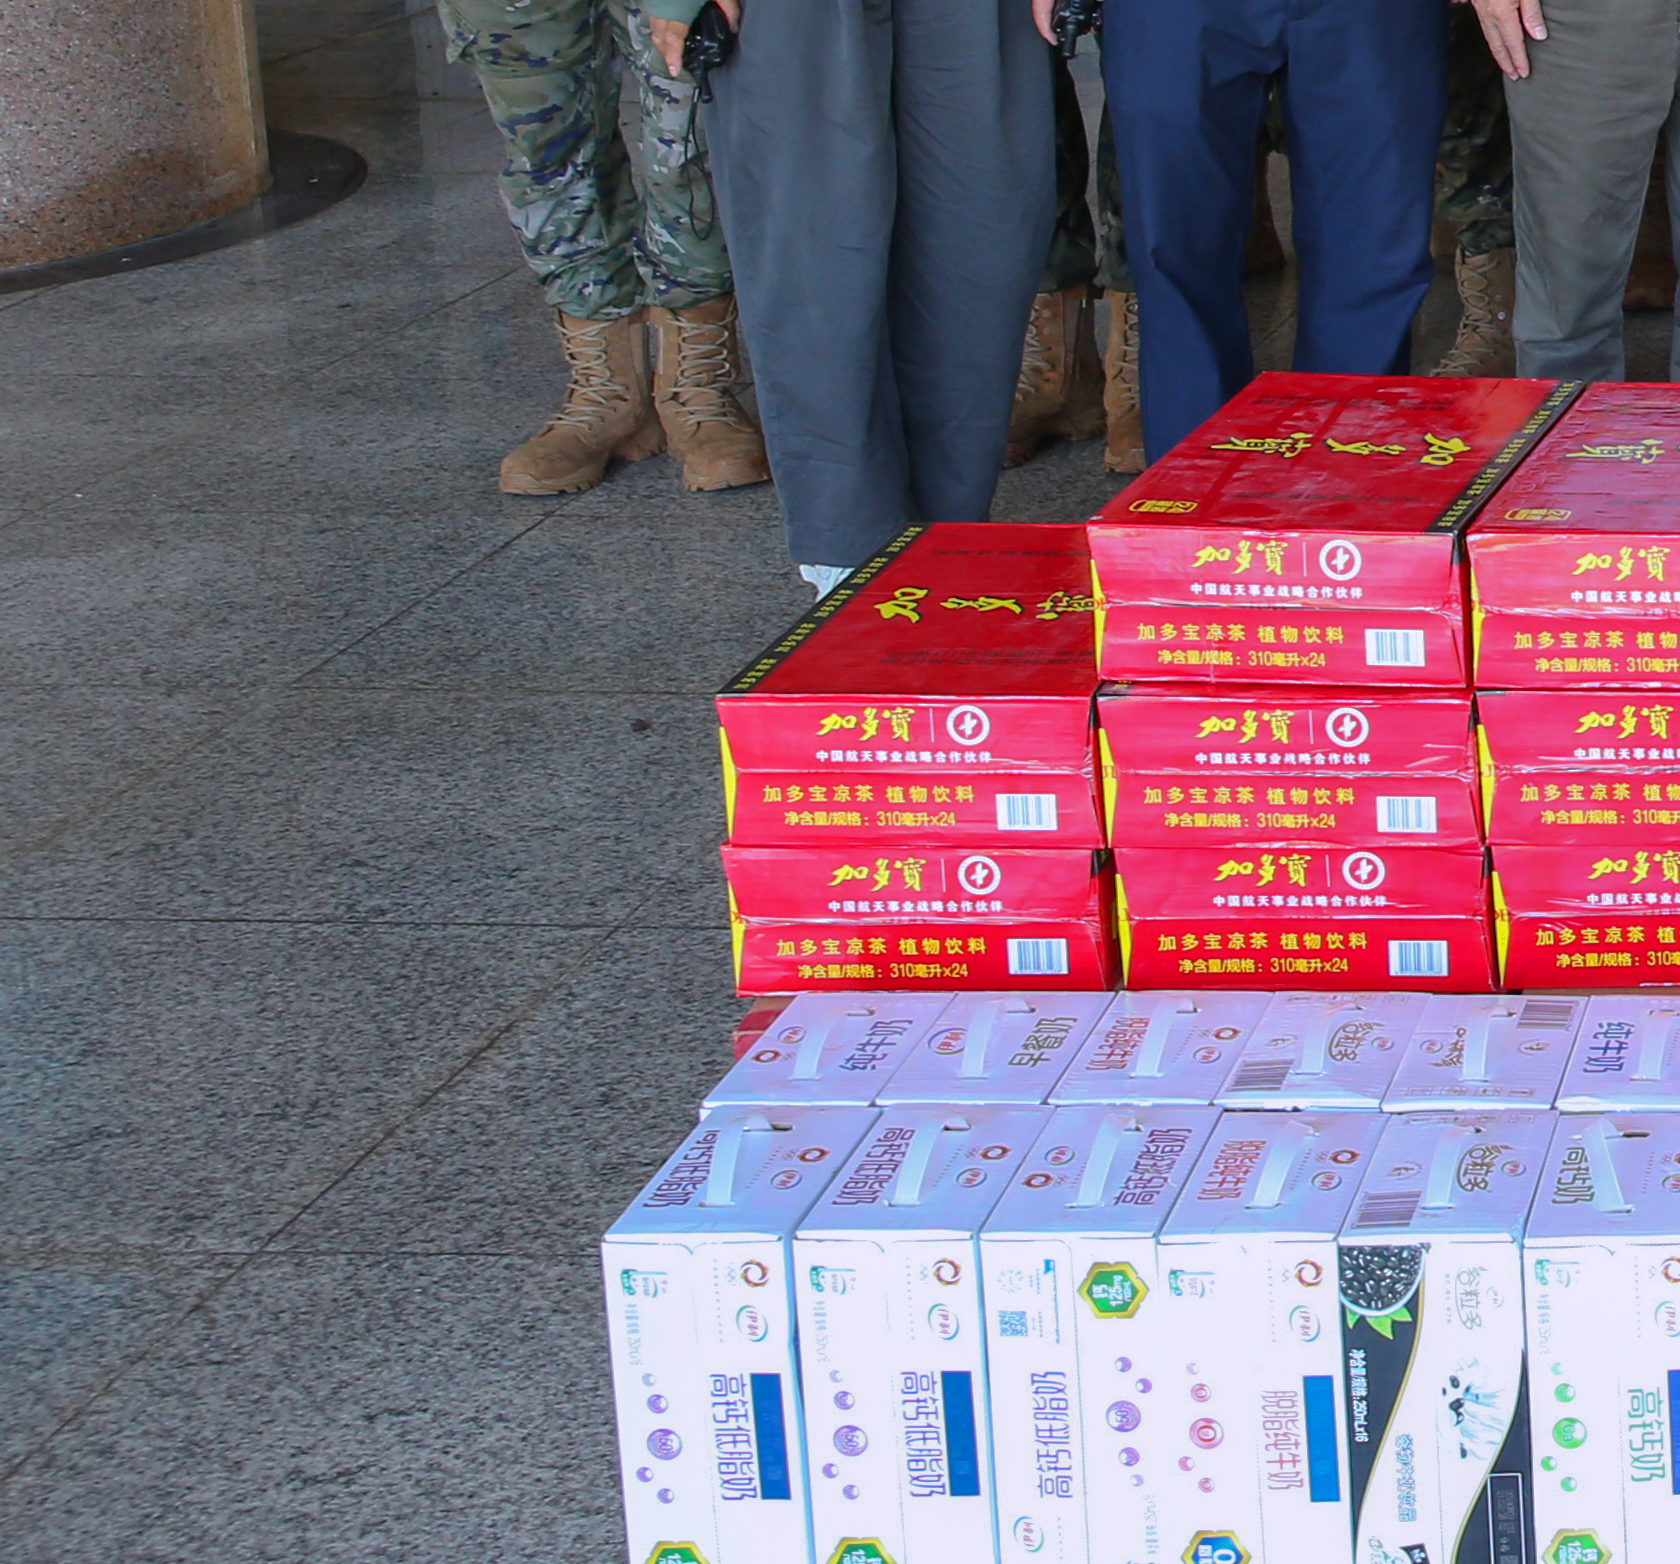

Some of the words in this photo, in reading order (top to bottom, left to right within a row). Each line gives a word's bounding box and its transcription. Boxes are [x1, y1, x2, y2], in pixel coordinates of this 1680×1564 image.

[1191, 584, 1362, 599] 中国航天事业战略合作伙伴
[1139, 624, 1245, 640] 加多宝凉茶
[1257, 627, 1344, 642] 植物饮料
[1515, 631, 1623, 647] 加多宝凉茶
[816, 750, 992, 763] 中国航天事业战略合作伙伴
[1196, 752, 1371, 765] 中国航天事业战略合作伙伴
[764, 786, 873, 801] 加多宝凉茶
[886, 787, 974, 802] 植物饮料
[1145, 787, 1253, 803] 加多宝凉茶
[1267, 788, 1354, 804] 植物饮料
[1521, 784, 1630, 801] 加多宝凉茶
[1159, 933, 1267, 950] 加多宝凉茶
[1281, 933, 1367, 949] 植物饮料
[1537, 927, 1644, 945] 加多宝凉茶
[778, 938, 886, 955] 加多宝凉茶
[899, 938, 985, 954] 植物饮料
[709, 1373, 758, 1501] 高钙低脂奶
[900, 1371, 946, 1498] 高钙低脂奶
[1031, 1371, 1074, 1499] 高钙低脂奶
[1261, 1390, 1304, 1491] 脱脂纯牛奶
[1628, 1386, 1667, 1484] 高钙奶
